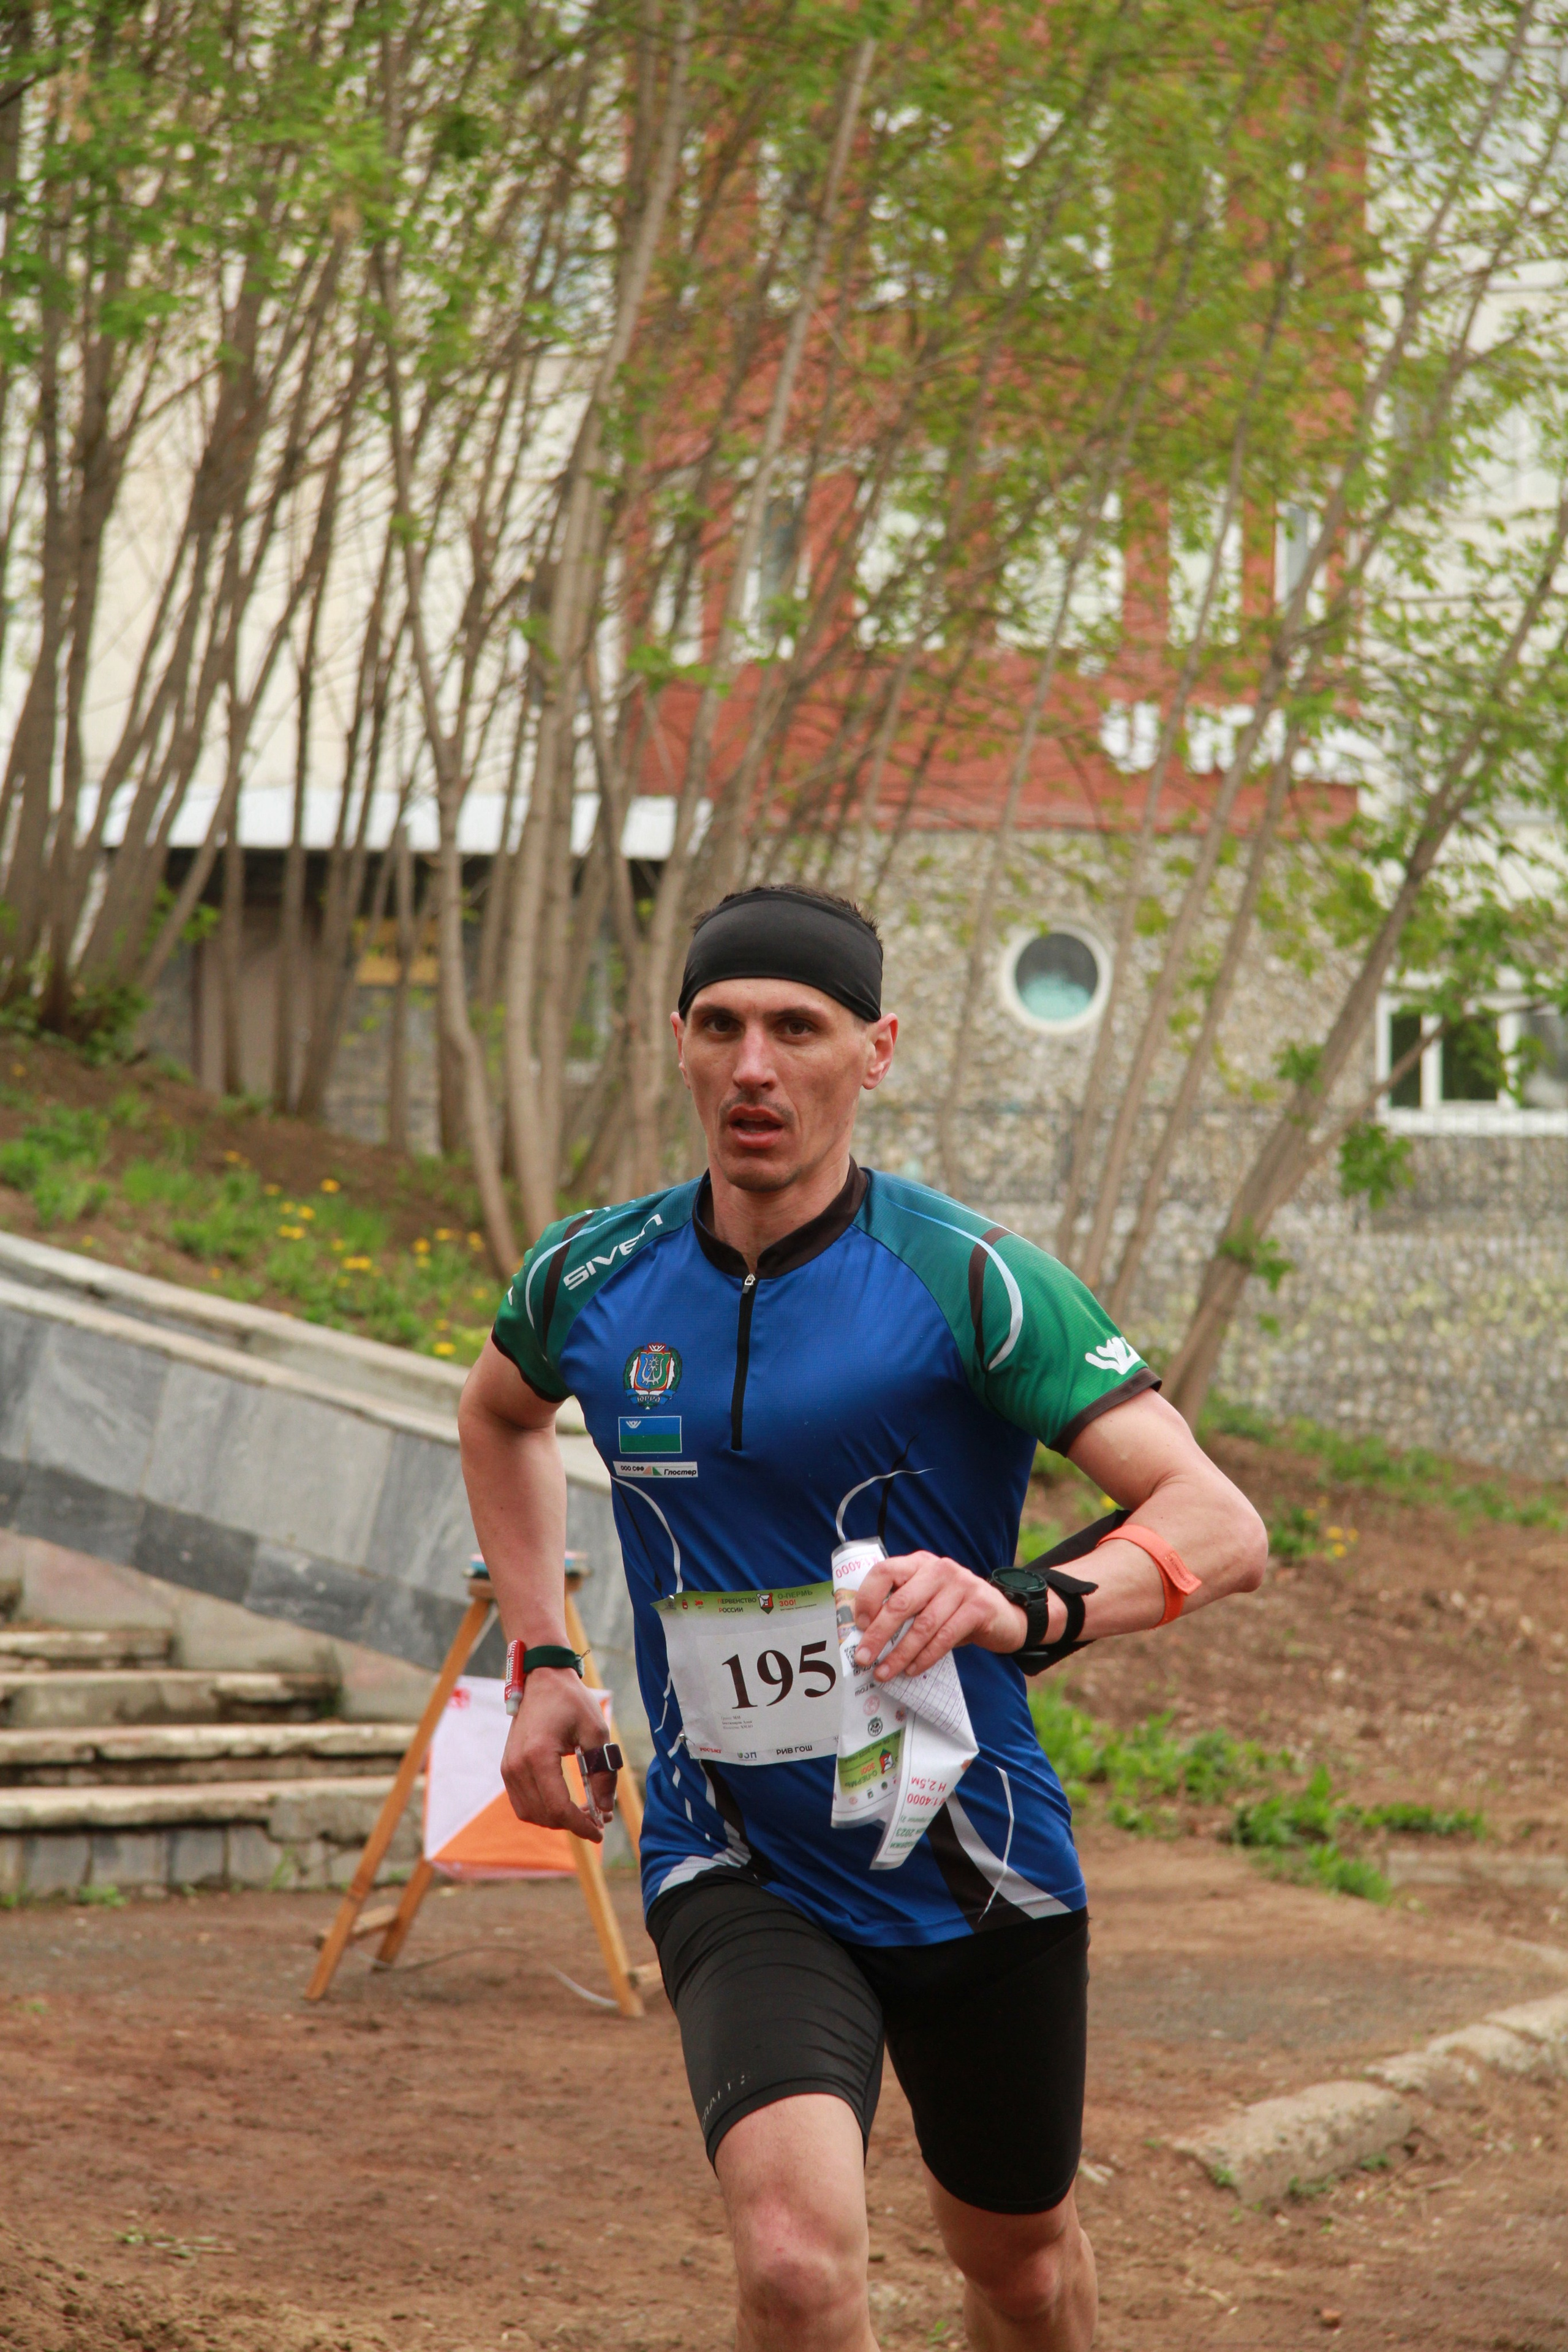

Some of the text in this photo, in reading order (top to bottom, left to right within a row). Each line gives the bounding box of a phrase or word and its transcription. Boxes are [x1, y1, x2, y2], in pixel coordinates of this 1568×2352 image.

[777, 1589, 813, 1599] О-ПЕРМЬ
[721, 1640, 837, 1709] 195
[895, 1827, 916, 1837] 2023
